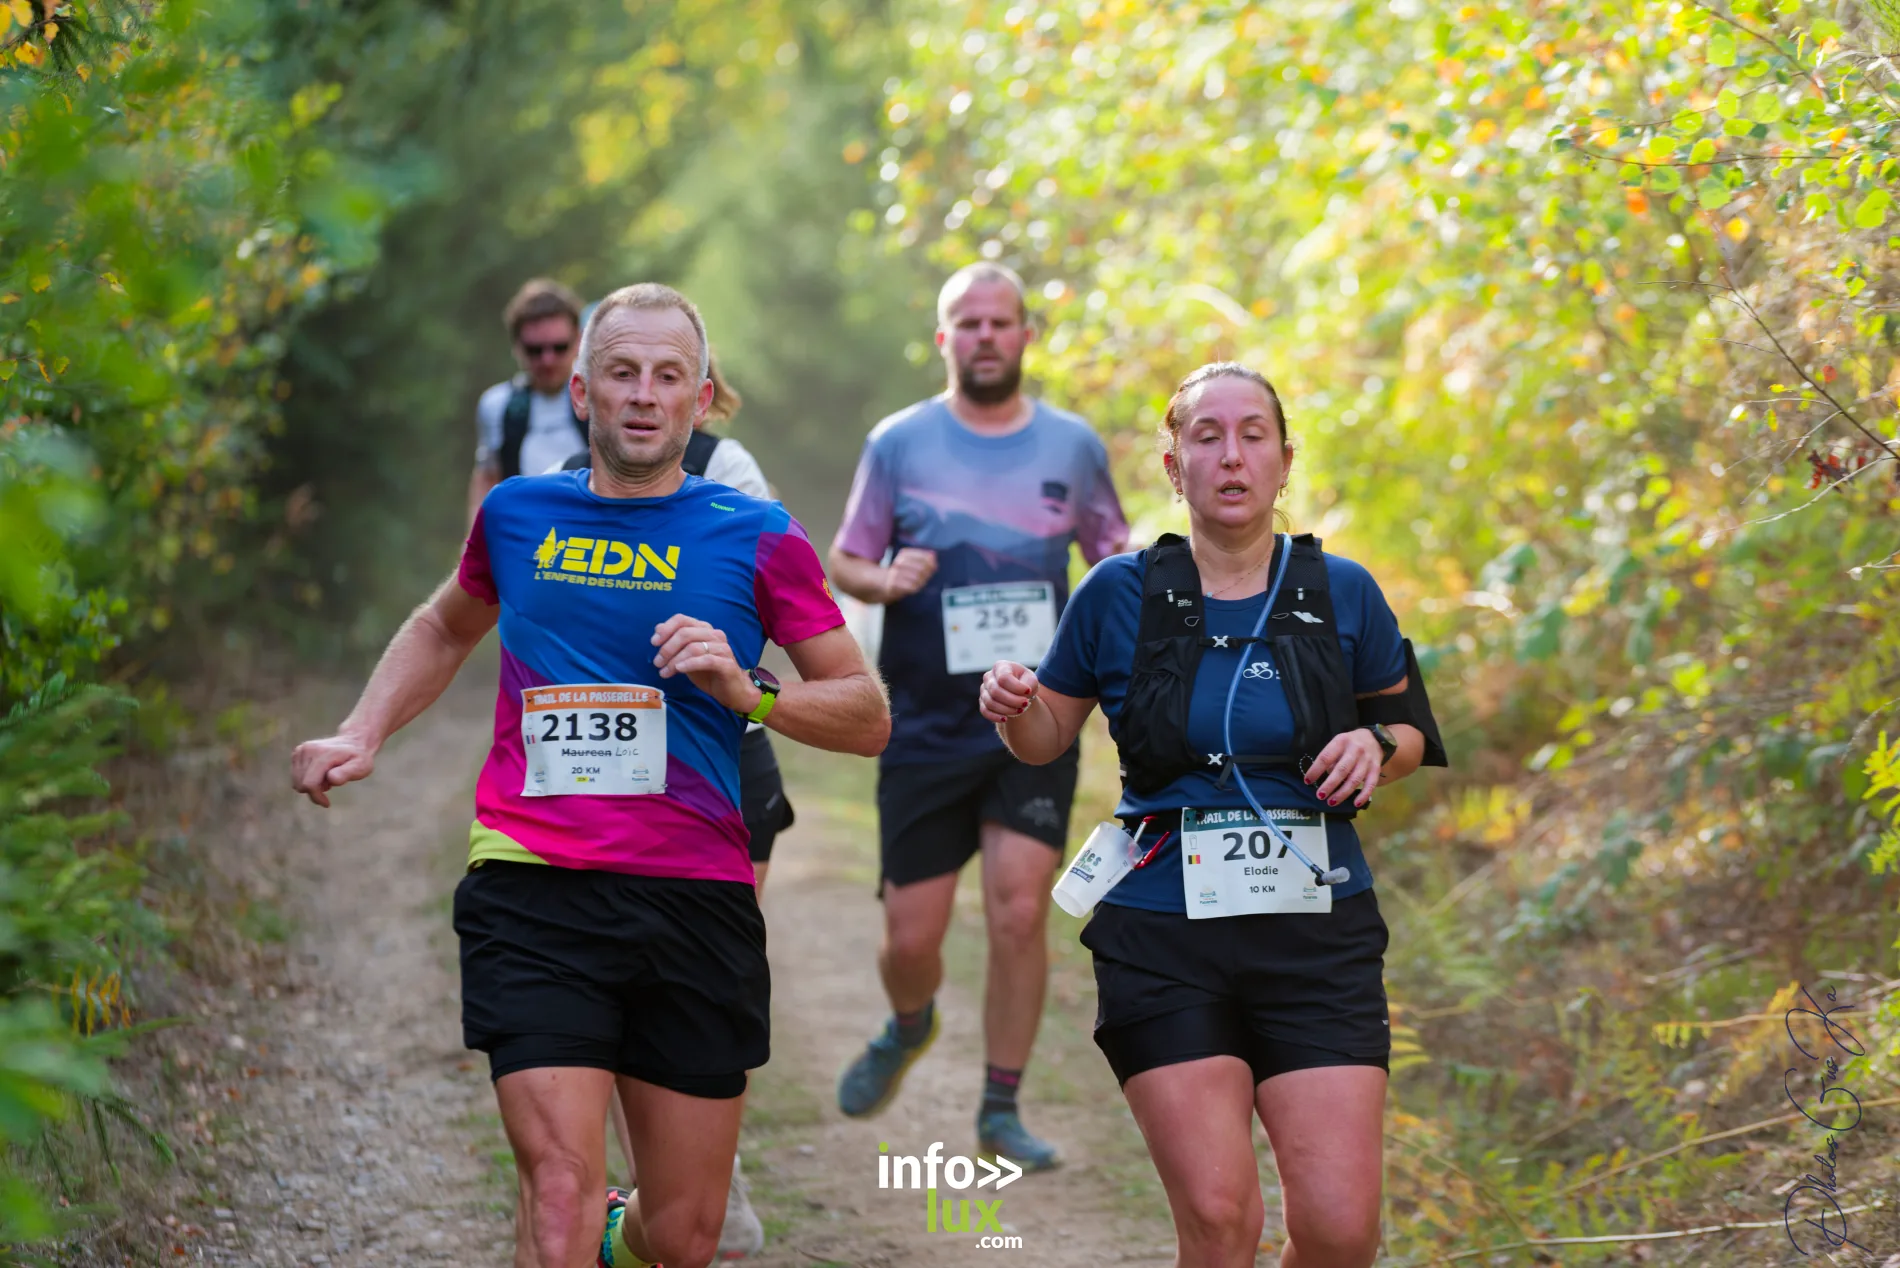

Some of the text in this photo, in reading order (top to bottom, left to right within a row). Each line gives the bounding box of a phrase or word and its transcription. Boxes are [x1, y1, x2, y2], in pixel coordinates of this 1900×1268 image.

[560, 536, 681, 580] EDN
[534, 570, 673, 592] L'ENFER DES NUTONS
[975, 604, 1029, 630] 256
[558, 691, 571, 703] DE
[573, 691, 587, 703] LA
[589, 690, 649, 703] PASSERELLE
[541, 712, 638, 742] 2138
[561, 747, 612, 757] Maureen
[571, 766, 601, 775] 20 KM
[1196, 812, 1225, 825] RAIL
[1227, 810, 1241, 822] DE
[1222, 830, 1293, 861] 207
[1243, 866, 1279, 876] Elodie
[1249, 885, 1276, 894] 10 KM
